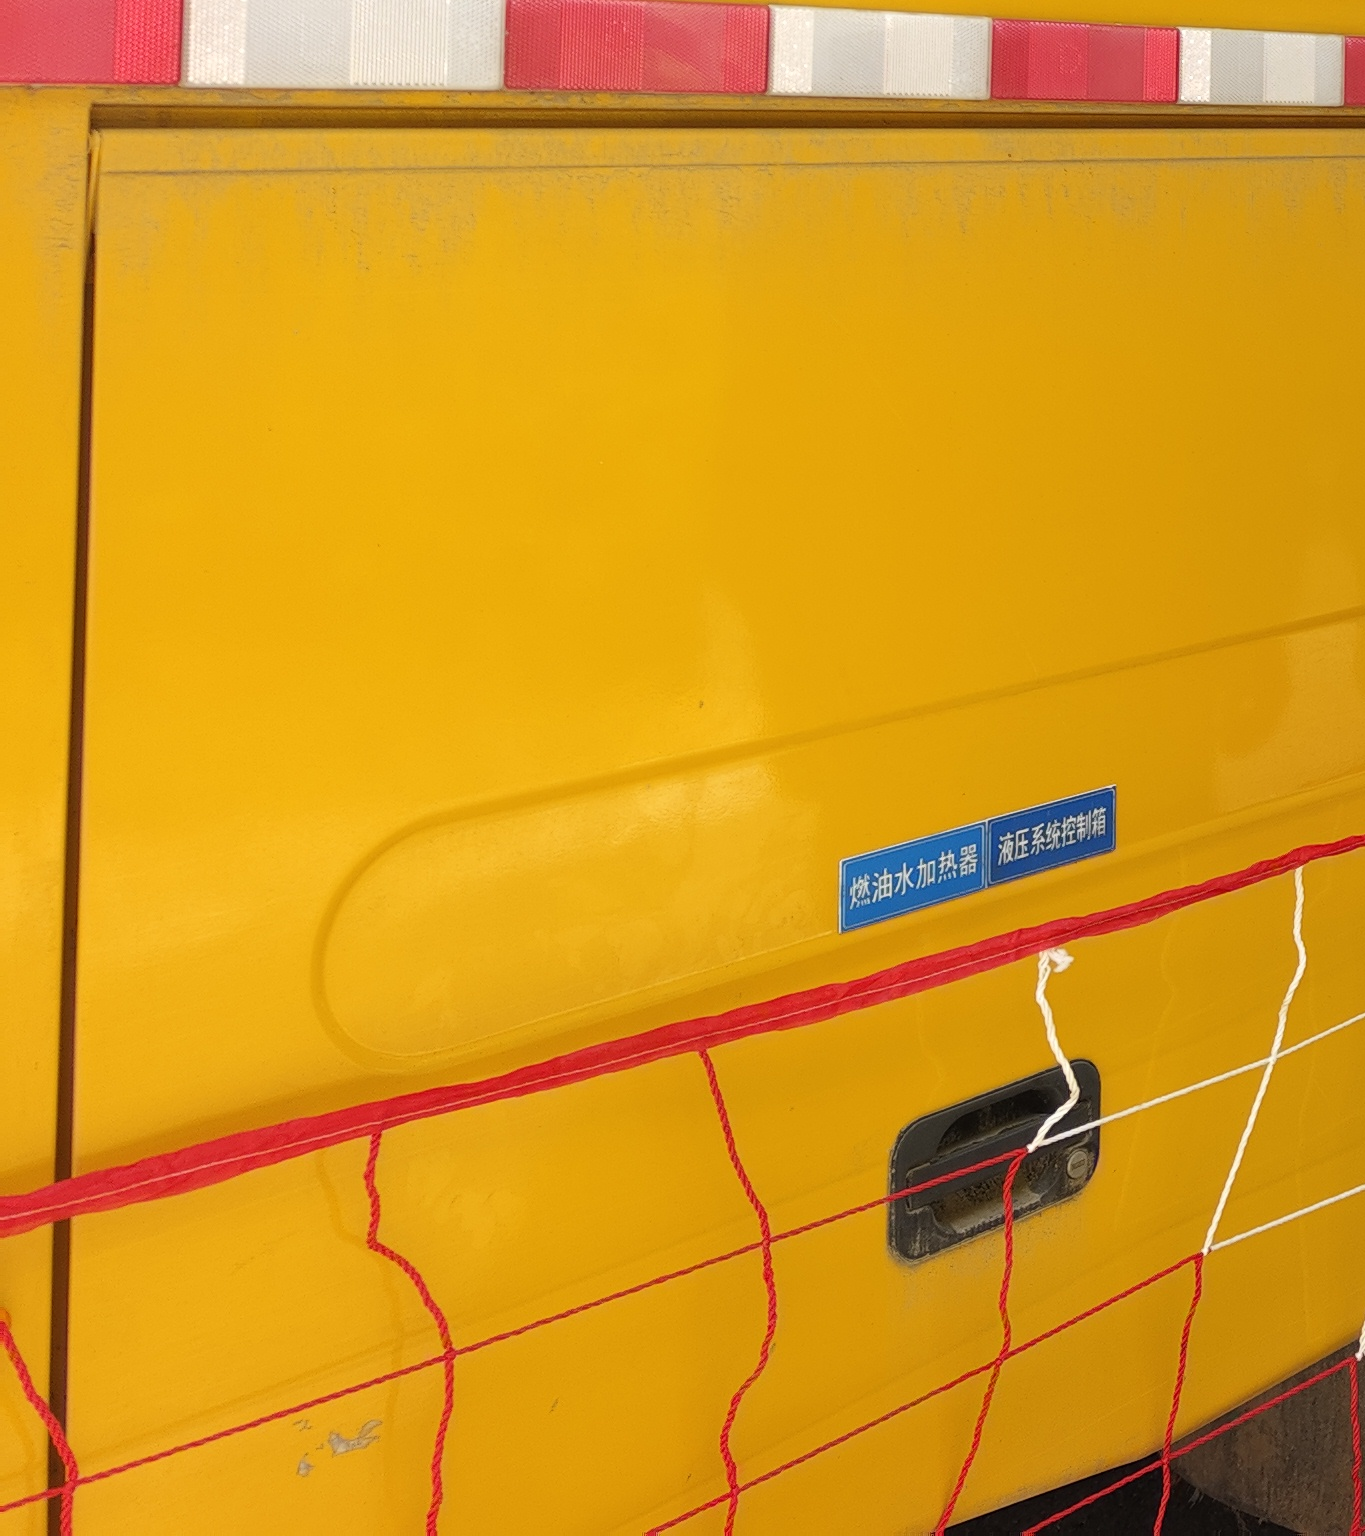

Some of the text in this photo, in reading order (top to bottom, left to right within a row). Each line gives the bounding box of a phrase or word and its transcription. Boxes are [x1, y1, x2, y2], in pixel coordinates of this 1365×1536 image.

[997, 807, 1107, 866] 液压系统控制箱
[849, 843, 979, 910] 燃油水加热器
